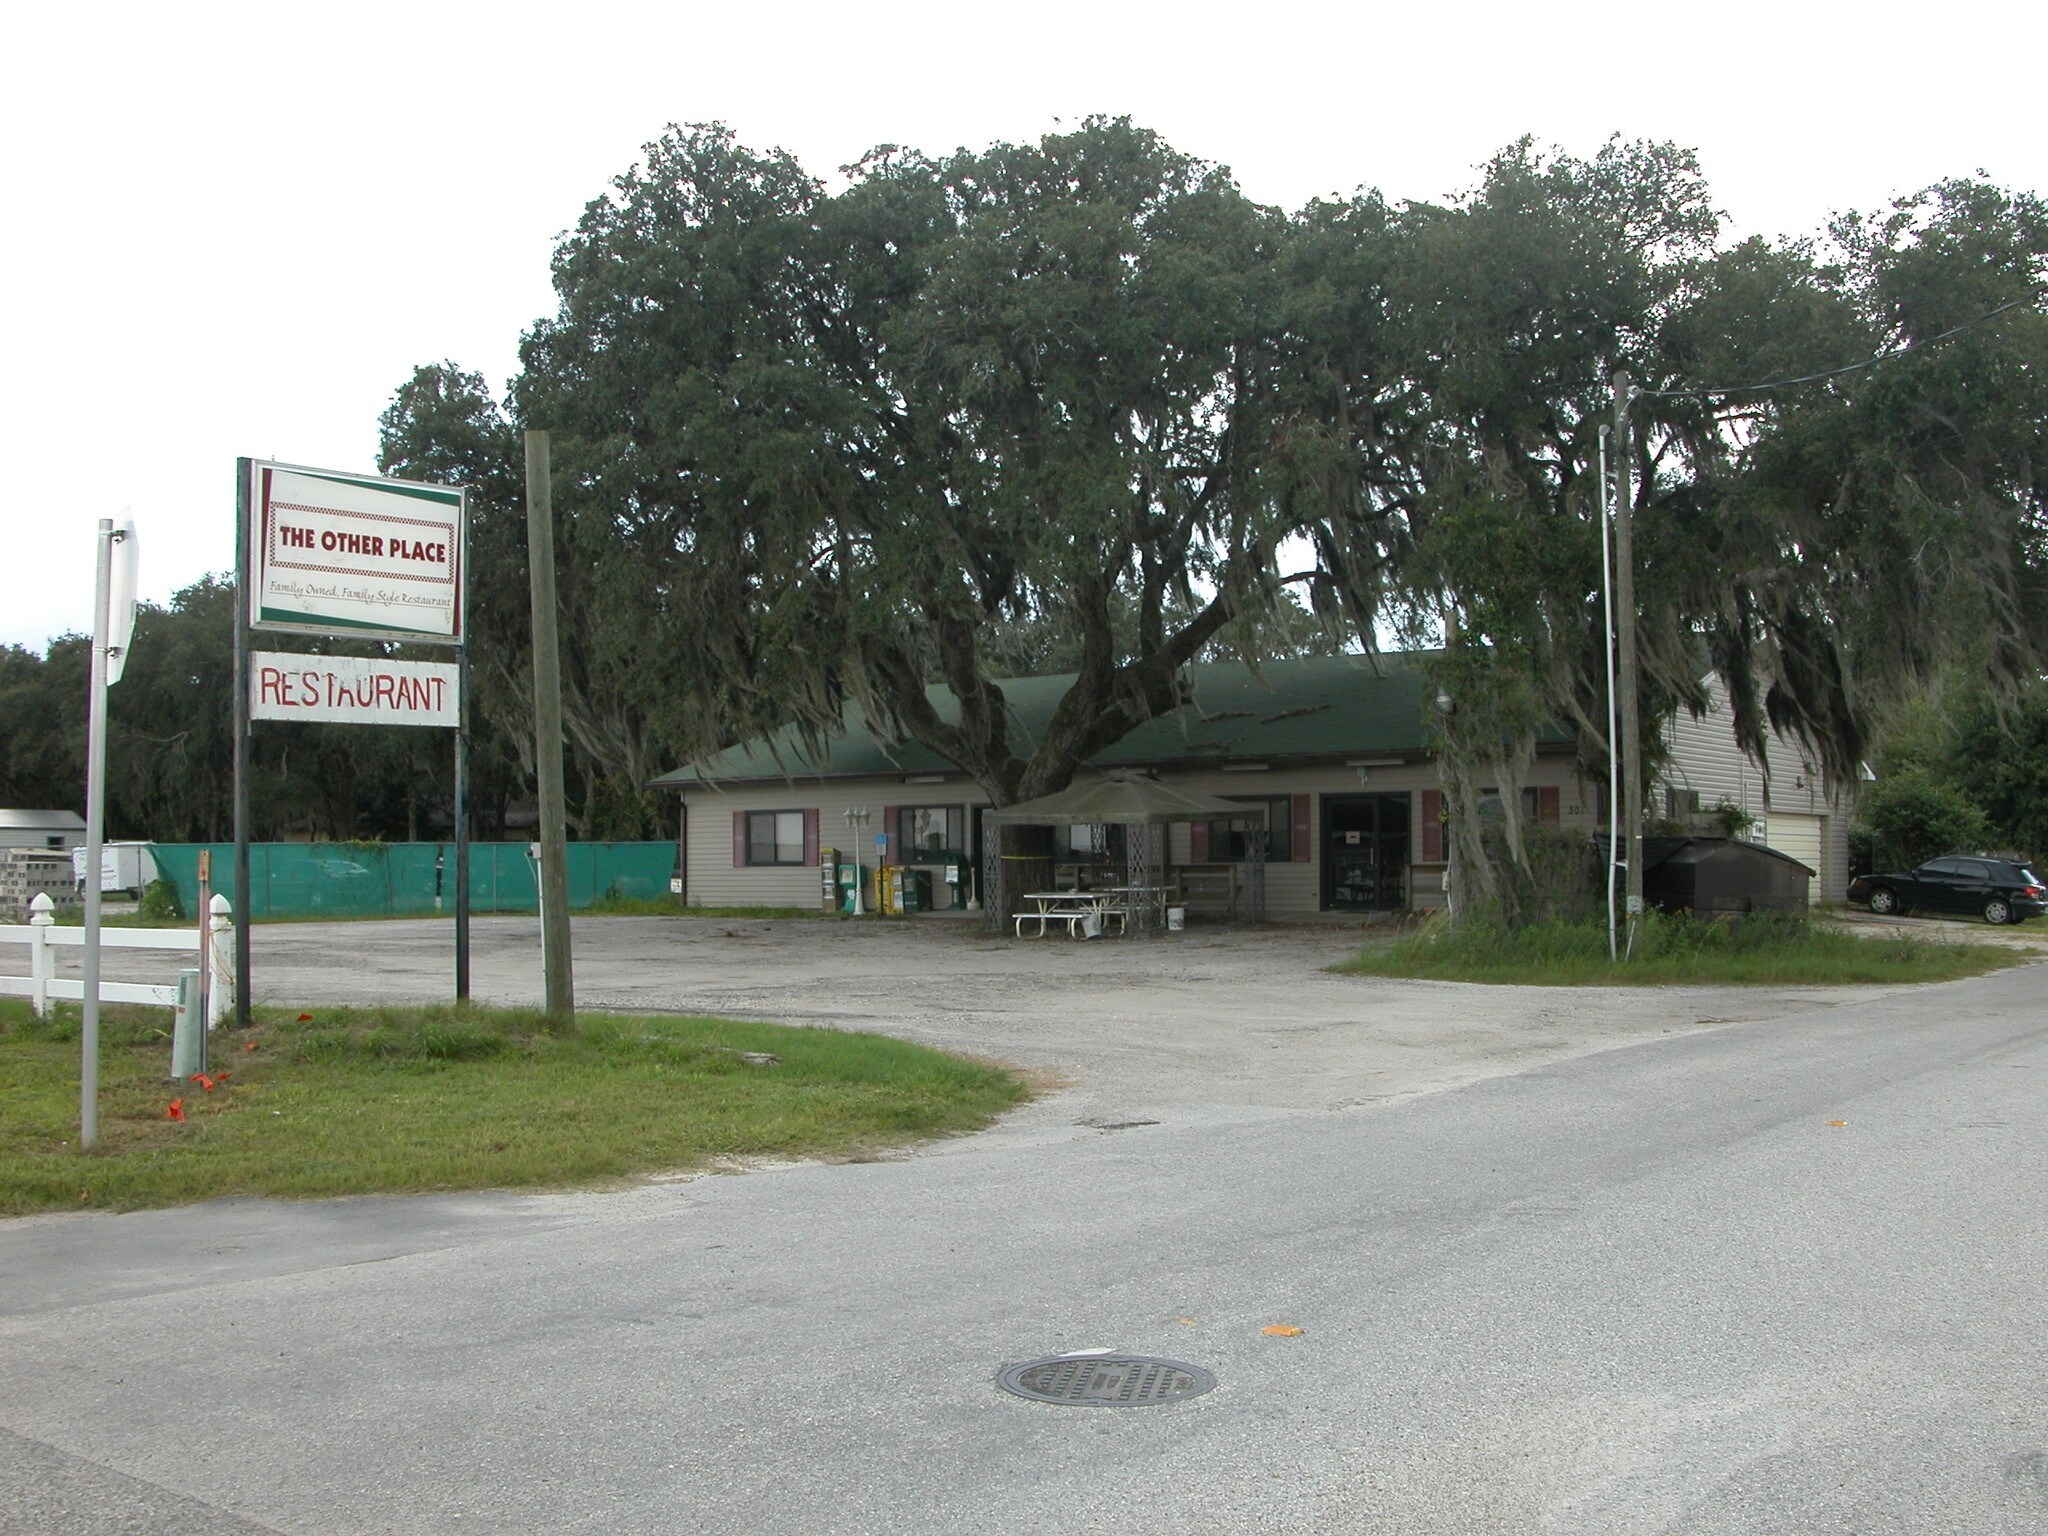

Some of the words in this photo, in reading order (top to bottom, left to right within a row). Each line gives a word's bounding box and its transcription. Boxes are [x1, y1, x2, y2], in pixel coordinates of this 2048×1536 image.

[280, 526, 315, 549] THE
[321, 531, 383, 556] OTHER
[390, 539, 446, 563] PLACE
[269, 581, 304, 598] Family
[342, 588, 375, 602] Family
[376, 590, 400, 607] Style
[402, 595, 451, 607] Restaurant
[261, 668, 447, 711] RESTAURANT
